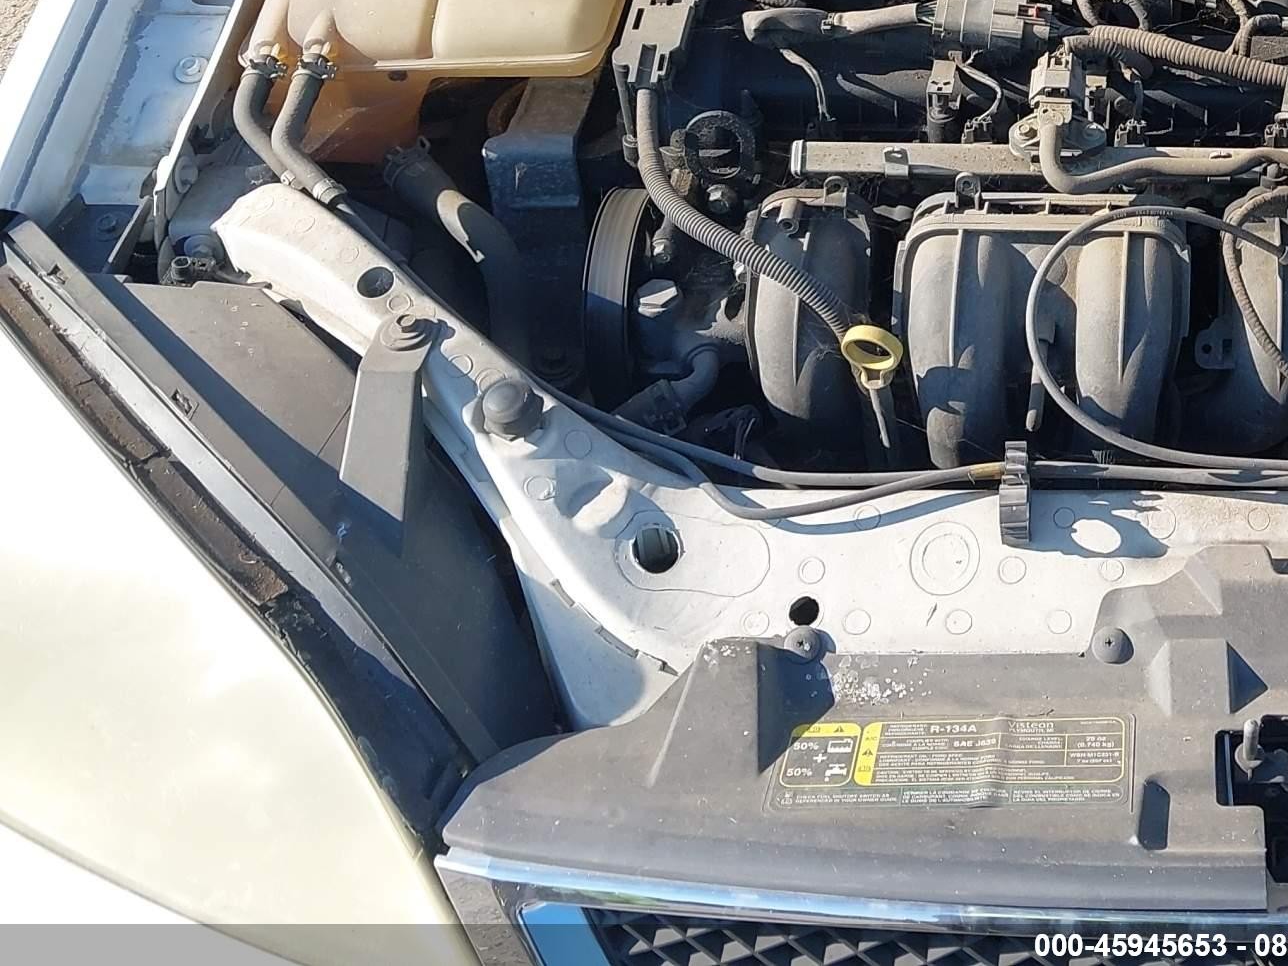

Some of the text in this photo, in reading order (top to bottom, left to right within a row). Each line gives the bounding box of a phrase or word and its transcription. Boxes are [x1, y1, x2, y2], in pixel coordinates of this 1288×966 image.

[930, 724, 977, 734] R-134A
[1008, 721, 1054, 729] Visteon
[793, 742, 819, 751] 50%
[786, 768, 812, 777] 50%
